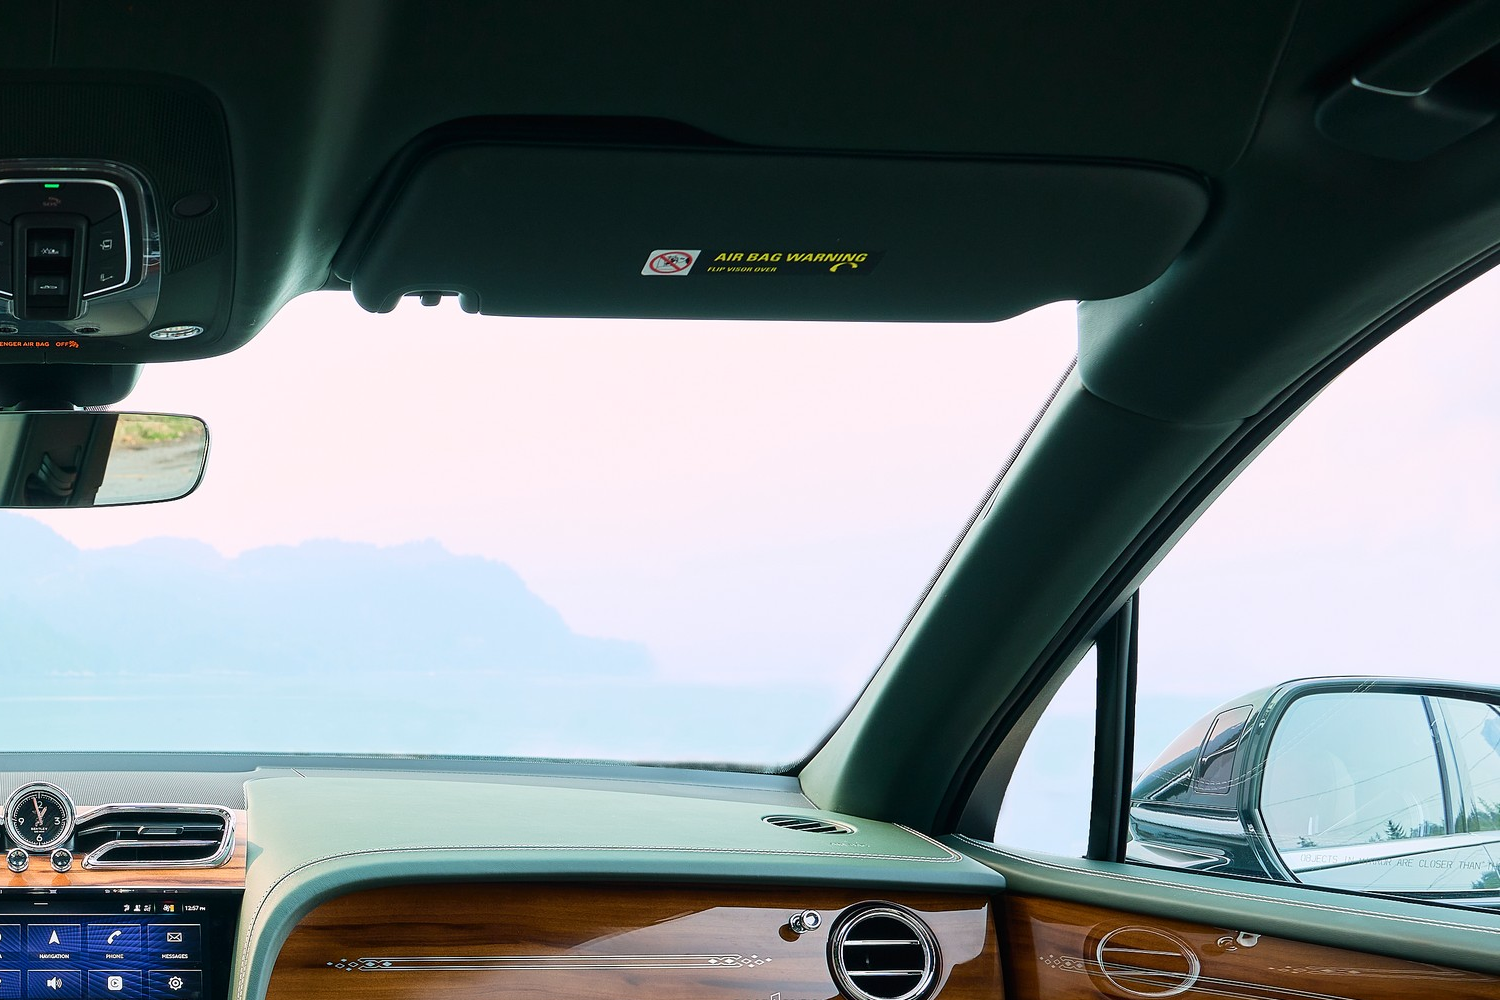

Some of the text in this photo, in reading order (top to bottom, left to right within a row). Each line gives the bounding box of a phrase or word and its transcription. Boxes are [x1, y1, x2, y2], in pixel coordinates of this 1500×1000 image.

[715, 253, 868, 263] AIR BAG WARNING
[18, 818, 25, 826] 9
[54, 817, 61, 825] 3
[36, 834, 43, 842] 6
[1300, 854, 1338, 863] OBJECTS
[1397, 859, 1414, 868] ARE
[1419, 859, 1453, 869] CLOSER
[1459, 861, 1482, 870] THAN
